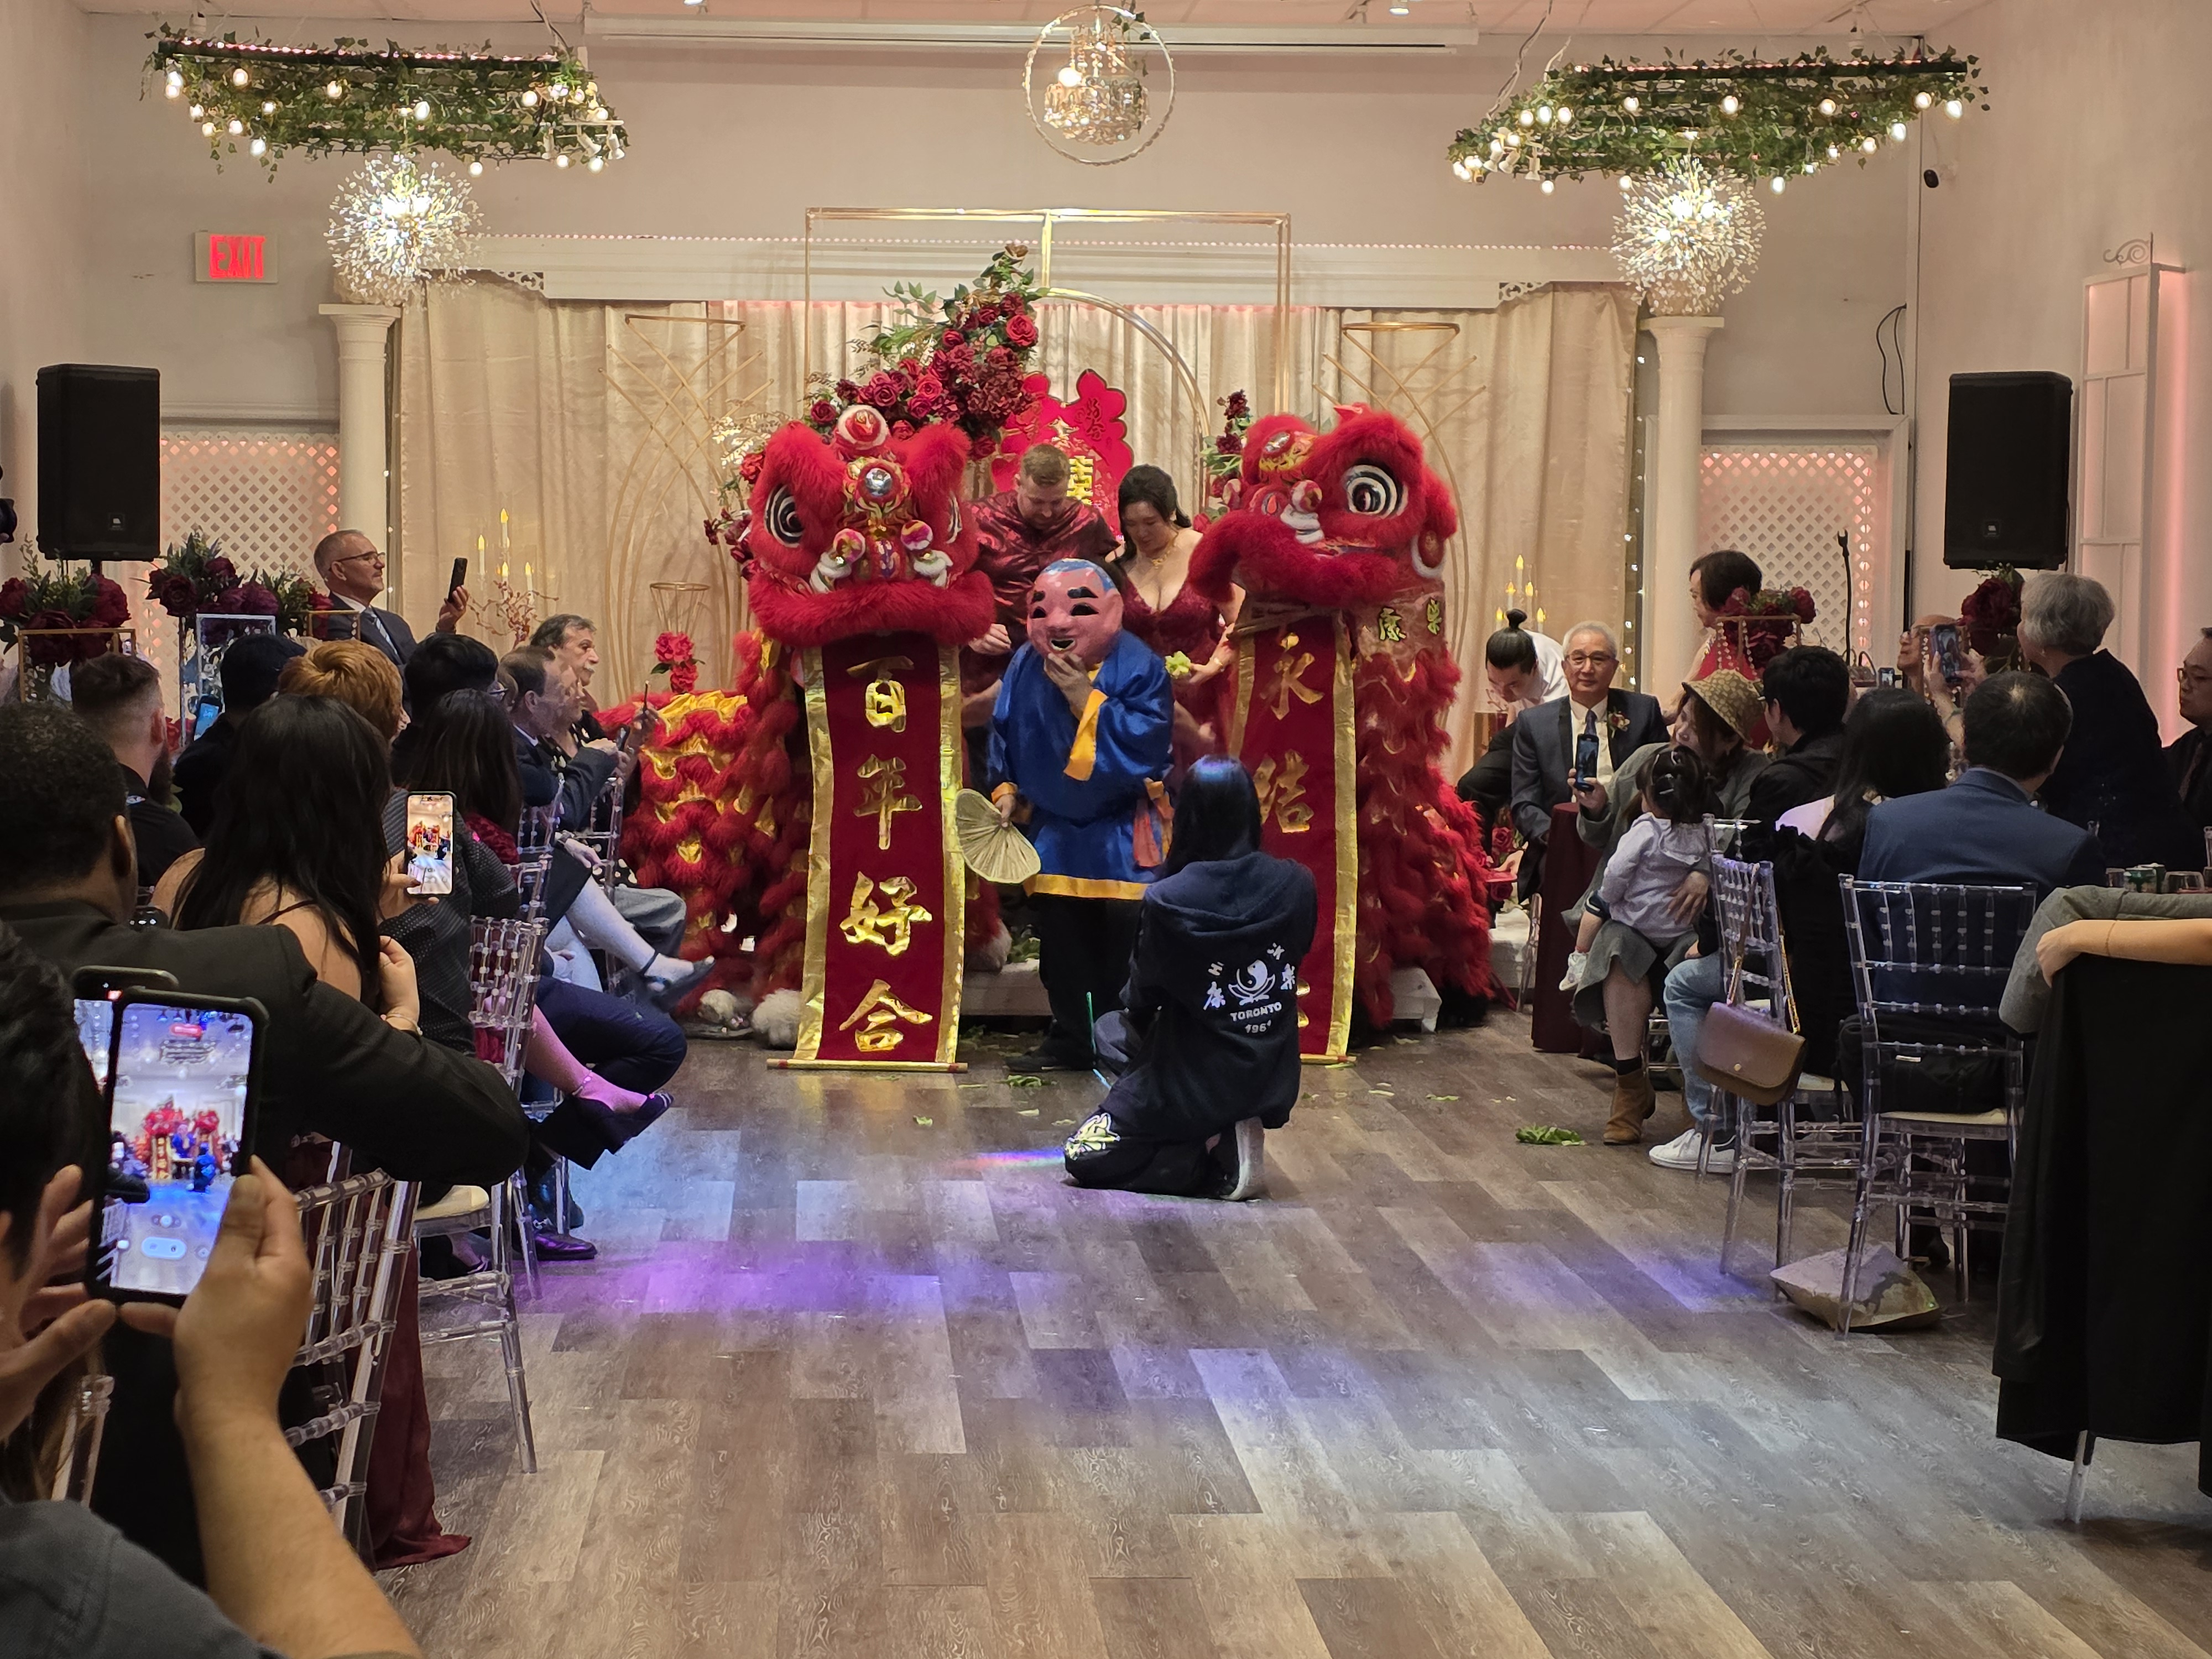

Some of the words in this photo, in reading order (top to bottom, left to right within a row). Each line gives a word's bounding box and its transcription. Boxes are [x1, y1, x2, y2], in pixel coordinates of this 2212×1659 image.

[210, 235, 265, 279] EXIT
[839, 655, 932, 1052] 百年好合
[1230, 1001, 1282, 1021] TORONTO
